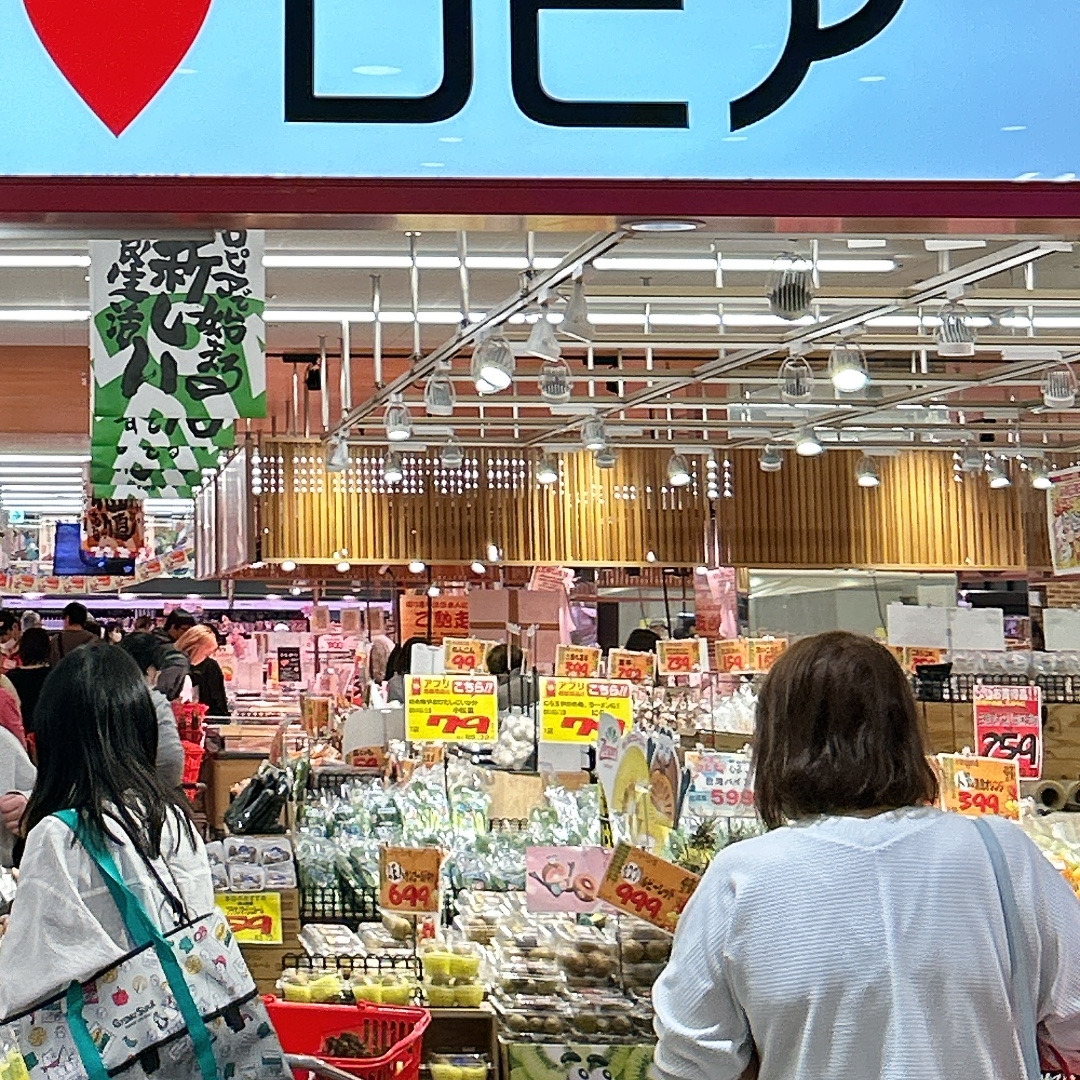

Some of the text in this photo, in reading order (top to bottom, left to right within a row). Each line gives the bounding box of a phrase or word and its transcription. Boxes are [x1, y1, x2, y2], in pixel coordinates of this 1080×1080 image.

[452, 655, 475, 669] 99
[426, 715, 491, 734] 79
[981, 732, 1040, 769] 259
[958, 791, 1000, 815] 399
[389, 883, 431, 908] 699
[616, 882, 663, 919] 999
